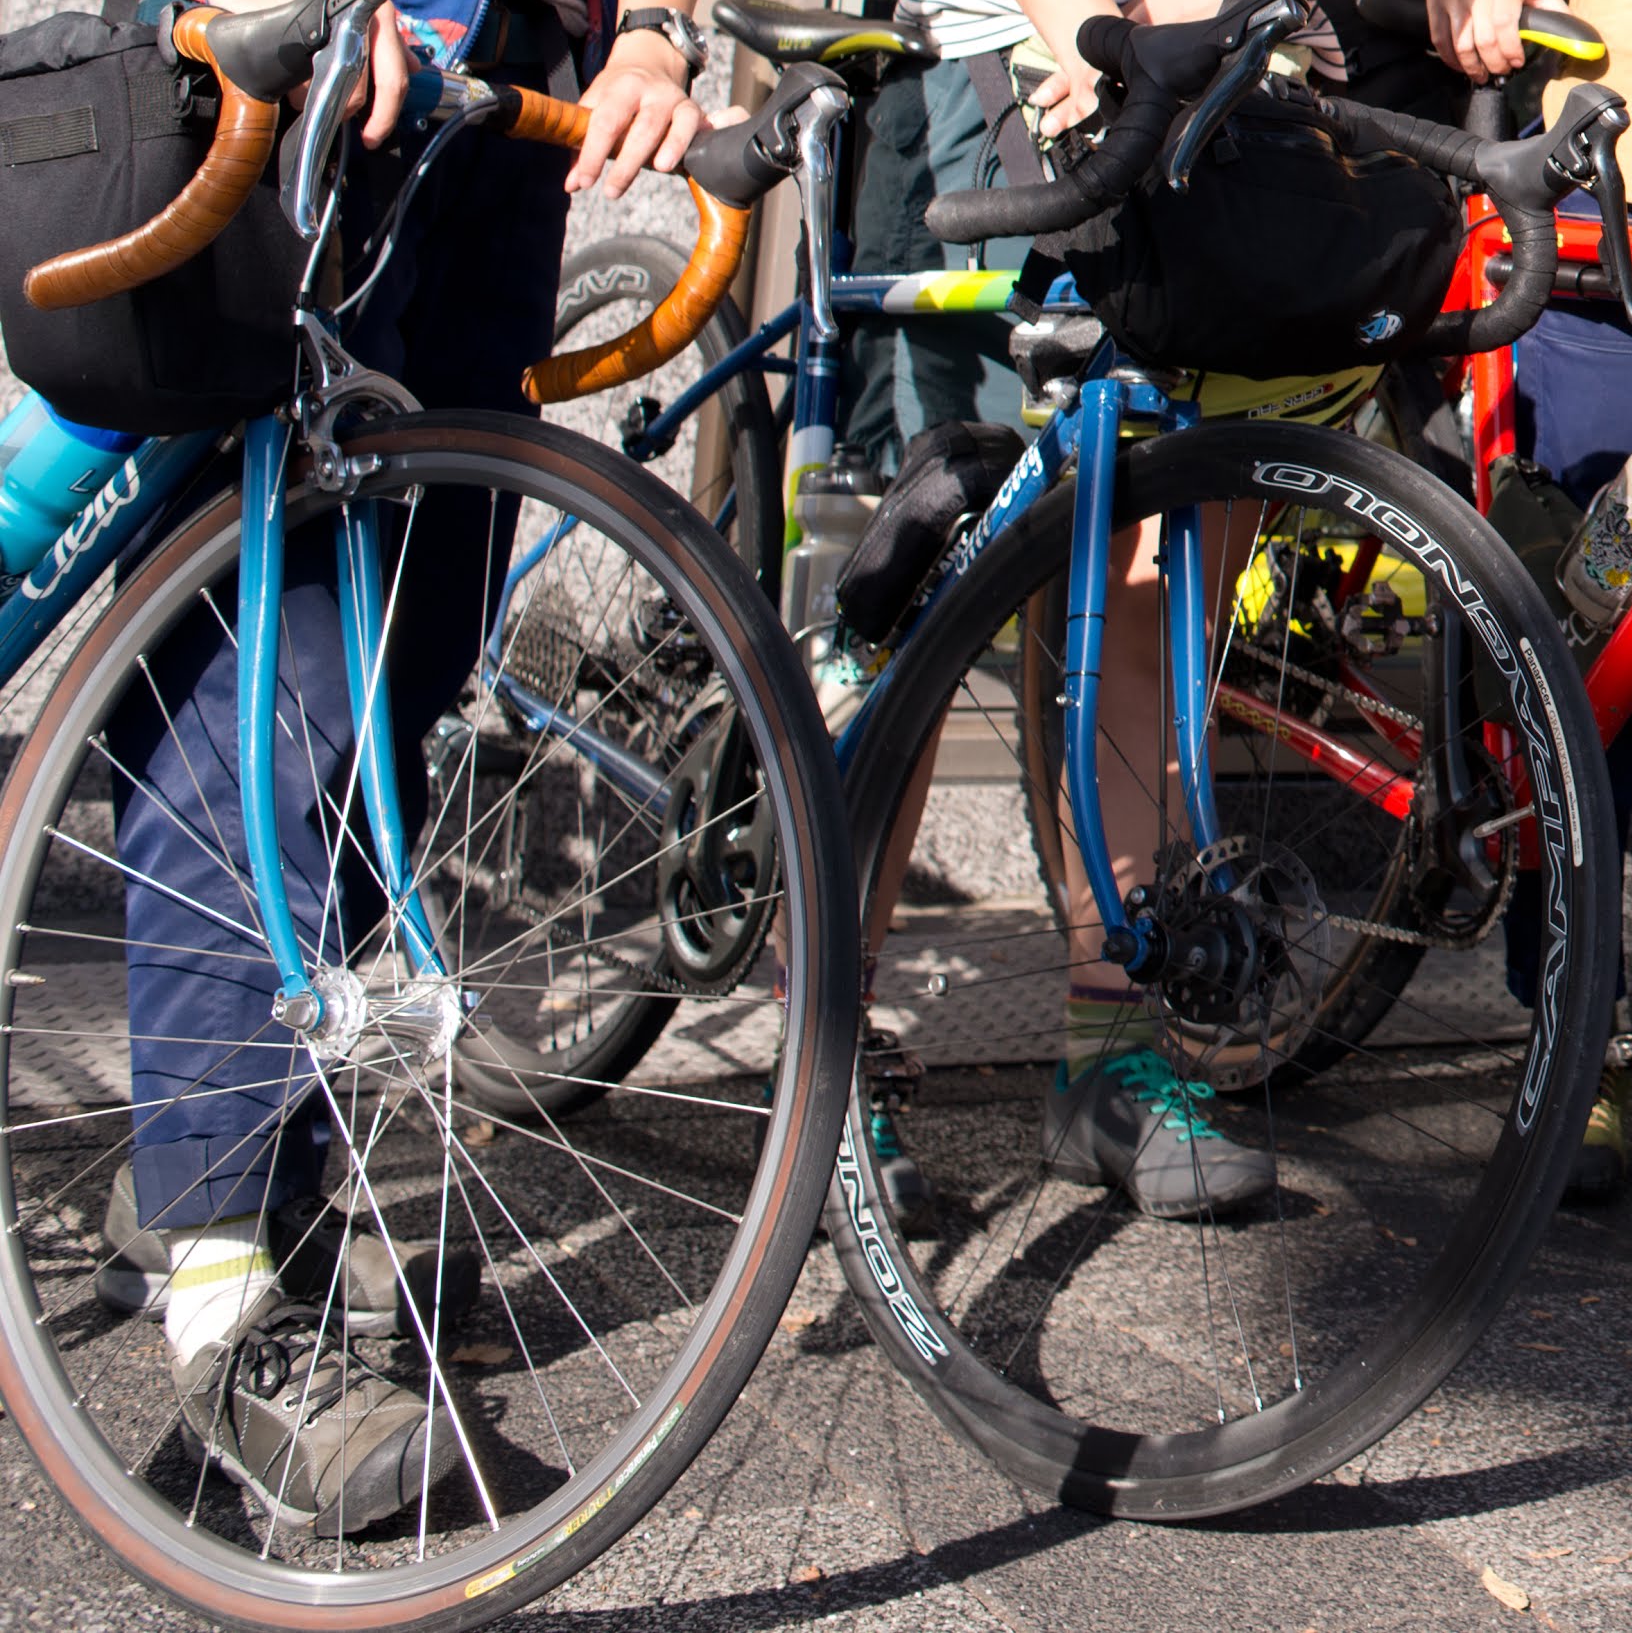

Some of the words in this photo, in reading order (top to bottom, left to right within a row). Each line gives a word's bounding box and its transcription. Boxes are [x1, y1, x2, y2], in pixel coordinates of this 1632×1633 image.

[1523, 647, 1551, 707] Panaracer
[1252, 460, 1568, 1137] CAMPAGNOLO
[614, 1435, 659, 1489] Panaracer
